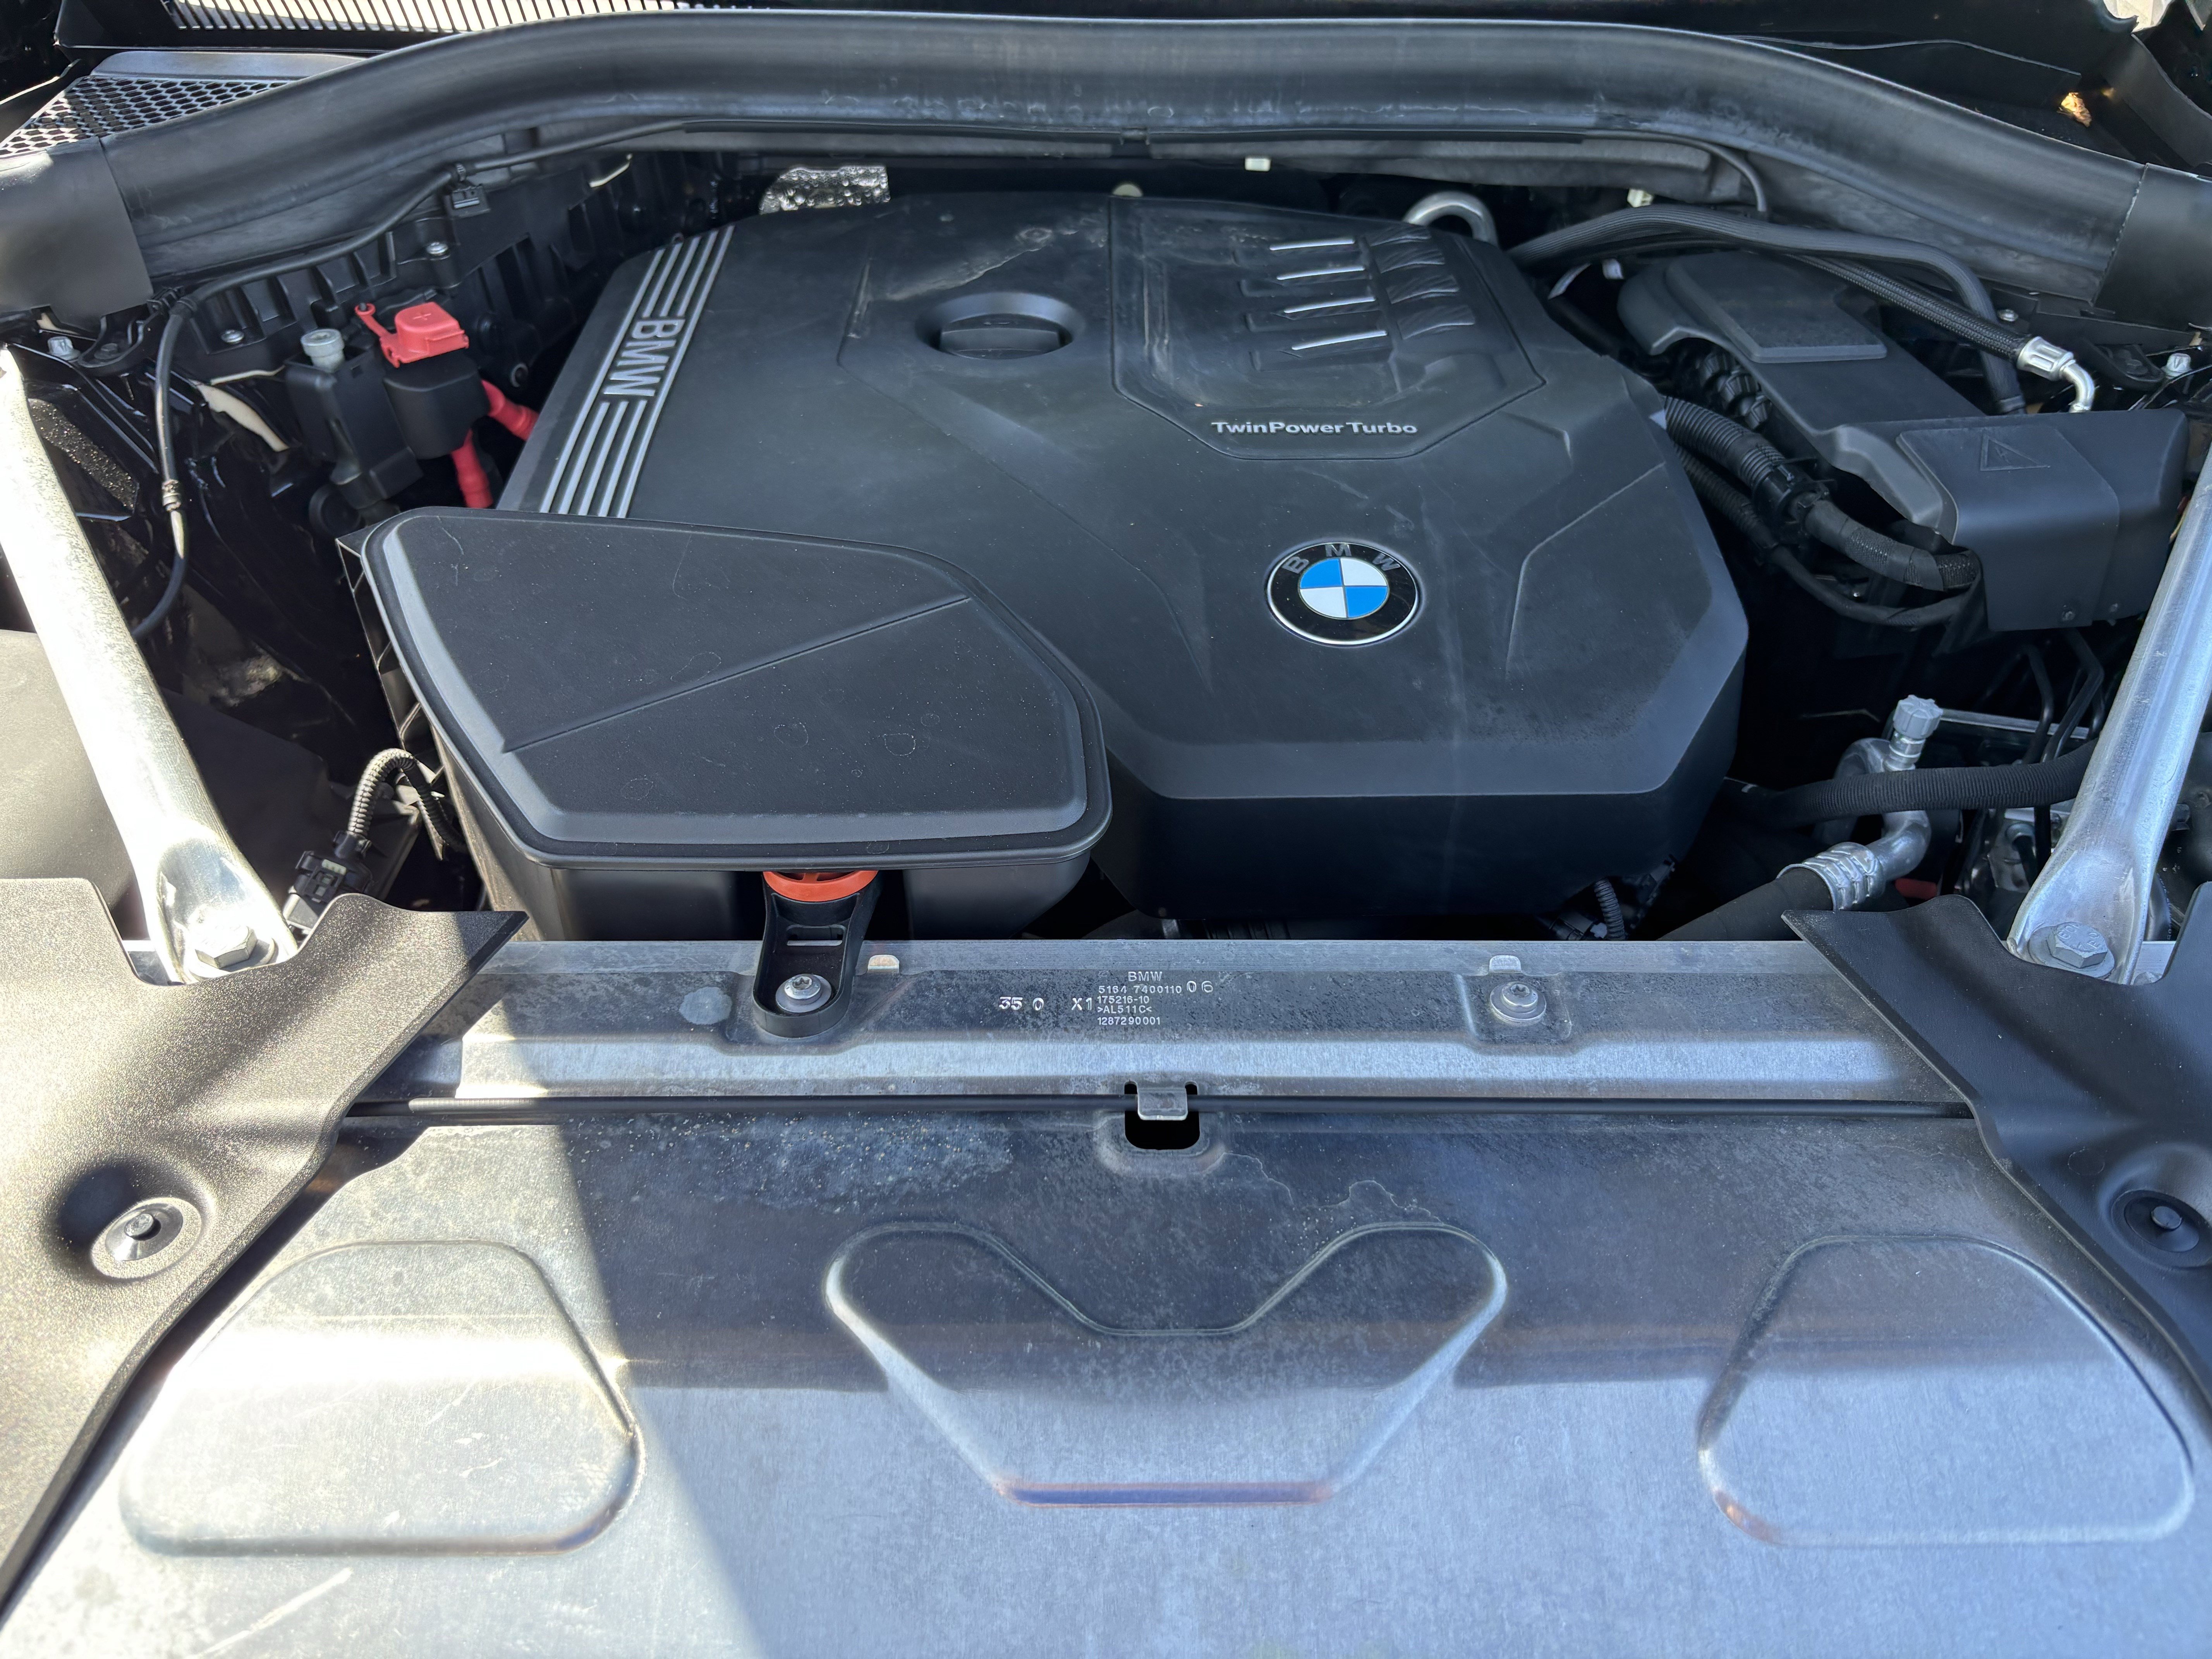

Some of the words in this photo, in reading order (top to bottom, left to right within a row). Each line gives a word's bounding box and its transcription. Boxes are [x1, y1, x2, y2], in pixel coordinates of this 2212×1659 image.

[603, 318, 685, 397] BMW
[1346, 422, 1418, 434] Turbo
[1282, 544, 1400, 574] BMW
[1128, 971, 1163, 982] BMW
[1098, 985, 1127, 994] 5164
[1133, 985, 1182, 994] 7400110
[1097, 995, 1150, 1004] 175216-10
[1097, 1005, 1152, 1014] >AL511C<
[1097, 1016, 1161, 1025] 1287290001
